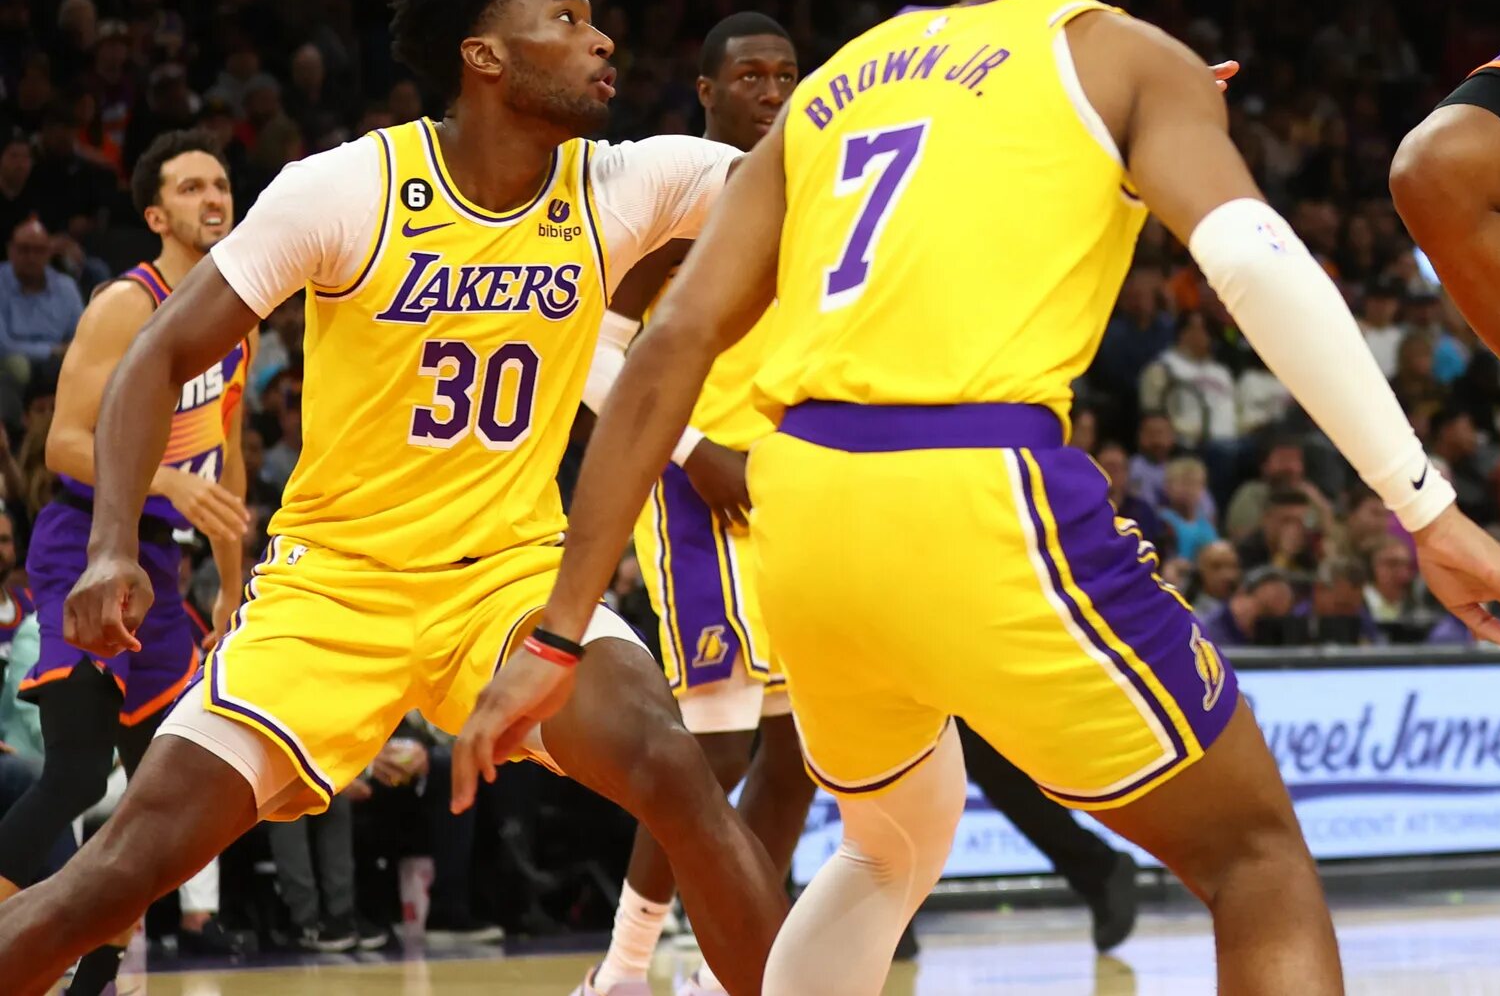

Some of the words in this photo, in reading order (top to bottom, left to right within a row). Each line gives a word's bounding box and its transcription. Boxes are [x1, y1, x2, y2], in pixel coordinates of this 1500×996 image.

[804, 44, 949, 131] BROWN
[407, 183, 427, 208] 6
[538, 223, 582, 242] bibigo
[819, 116, 933, 314] 7
[373, 251, 583, 324] LAKERS
[407, 338, 542, 451] 30
[1246, 692, 1374, 773] weet
